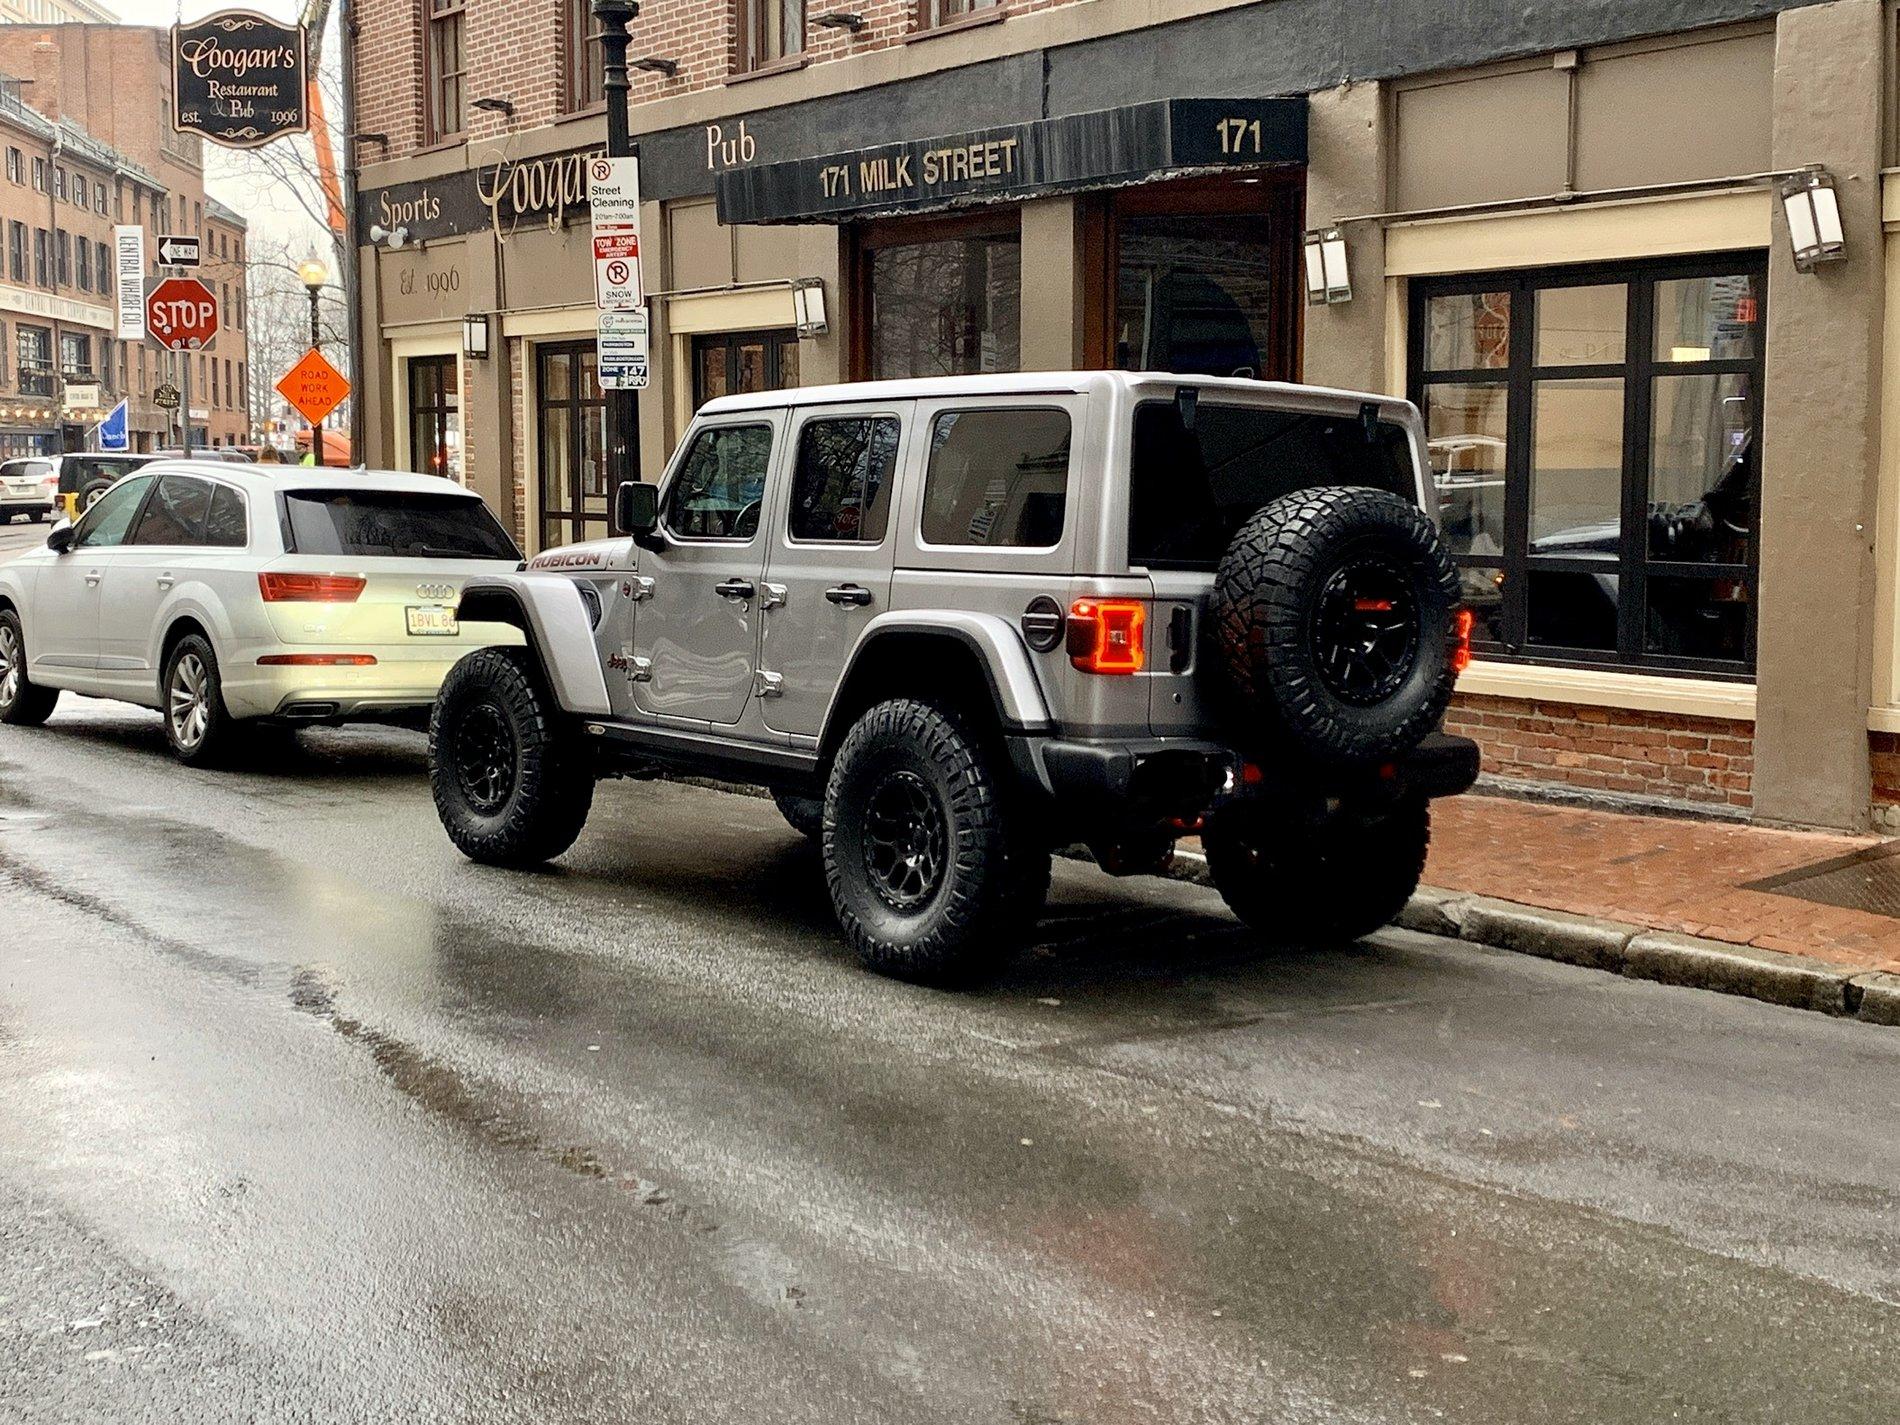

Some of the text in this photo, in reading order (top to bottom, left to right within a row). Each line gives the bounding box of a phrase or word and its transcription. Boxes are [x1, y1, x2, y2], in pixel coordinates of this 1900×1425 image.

[180, 36, 295, 77] Coogan's
[207, 80, 278, 100] Restaurant
[181, 108, 298, 125] est. 1996
[229, 99, 255, 118] Pub
[1216, 118, 1261, 154] 171
[706, 120, 756, 170] Pub
[819, 139, 1017, 198] 171 MILK STREET
[476, 131, 606, 245] Cooga
[591, 185, 621, 196] Street
[380, 188, 441, 231] Sports
[592, 197, 634, 209] Cleaning
[595, 236, 637, 248] TOW ZONE
[170, 245, 196, 257] ONE WAY
[119, 236, 142, 328] CENTRAL WHARF CO.
[426, 264, 460, 299] 1996
[606, 290, 633, 299] SNOW
[152, 300, 214, 329] STOP
[300, 370, 329, 380] ROAD
[622, 365, 645, 377] 147
[300, 383, 329, 393] WORK
[298, 396, 332, 406] AHEAD
[530, 553, 601, 569] RUBICON
[410, 613, 439, 627] 1BVL
